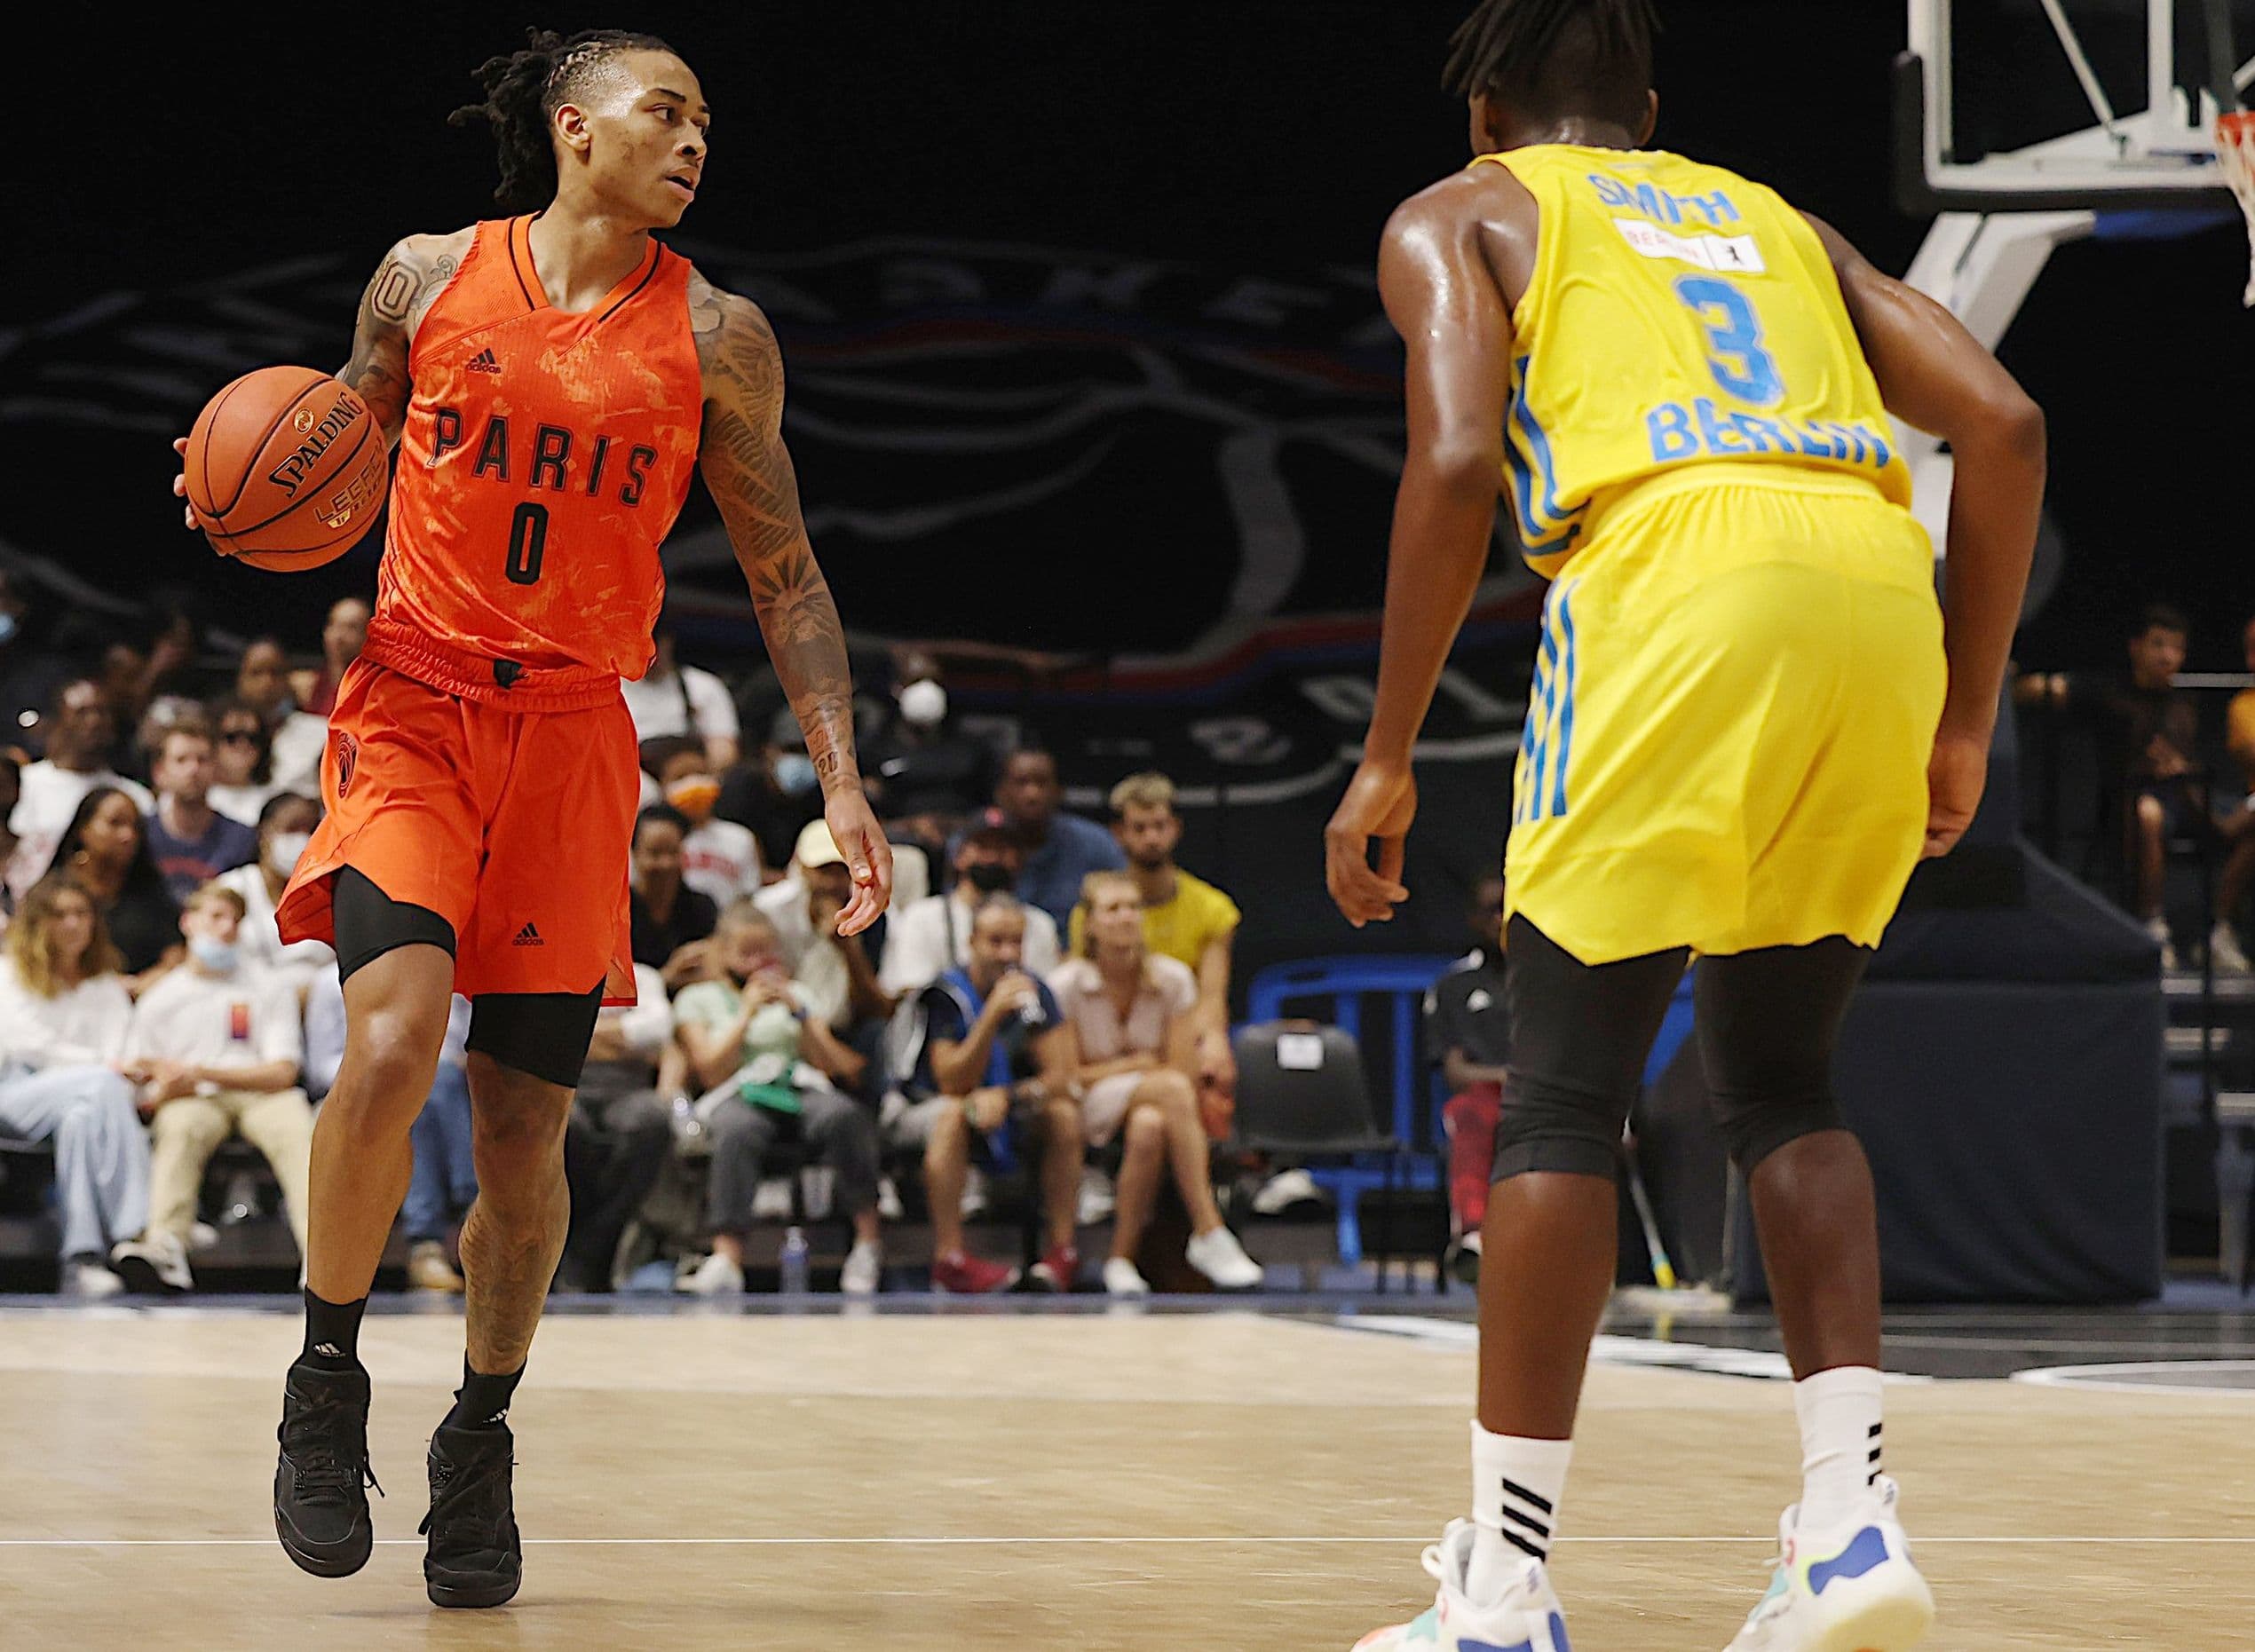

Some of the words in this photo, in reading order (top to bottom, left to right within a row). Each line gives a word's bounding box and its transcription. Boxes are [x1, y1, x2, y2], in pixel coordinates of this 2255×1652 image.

[1673, 274, 1785, 405] 3
[268, 391, 363, 498] SPALDING
[426, 407, 659, 507] PARIS
[505, 502, 549, 585] 0
